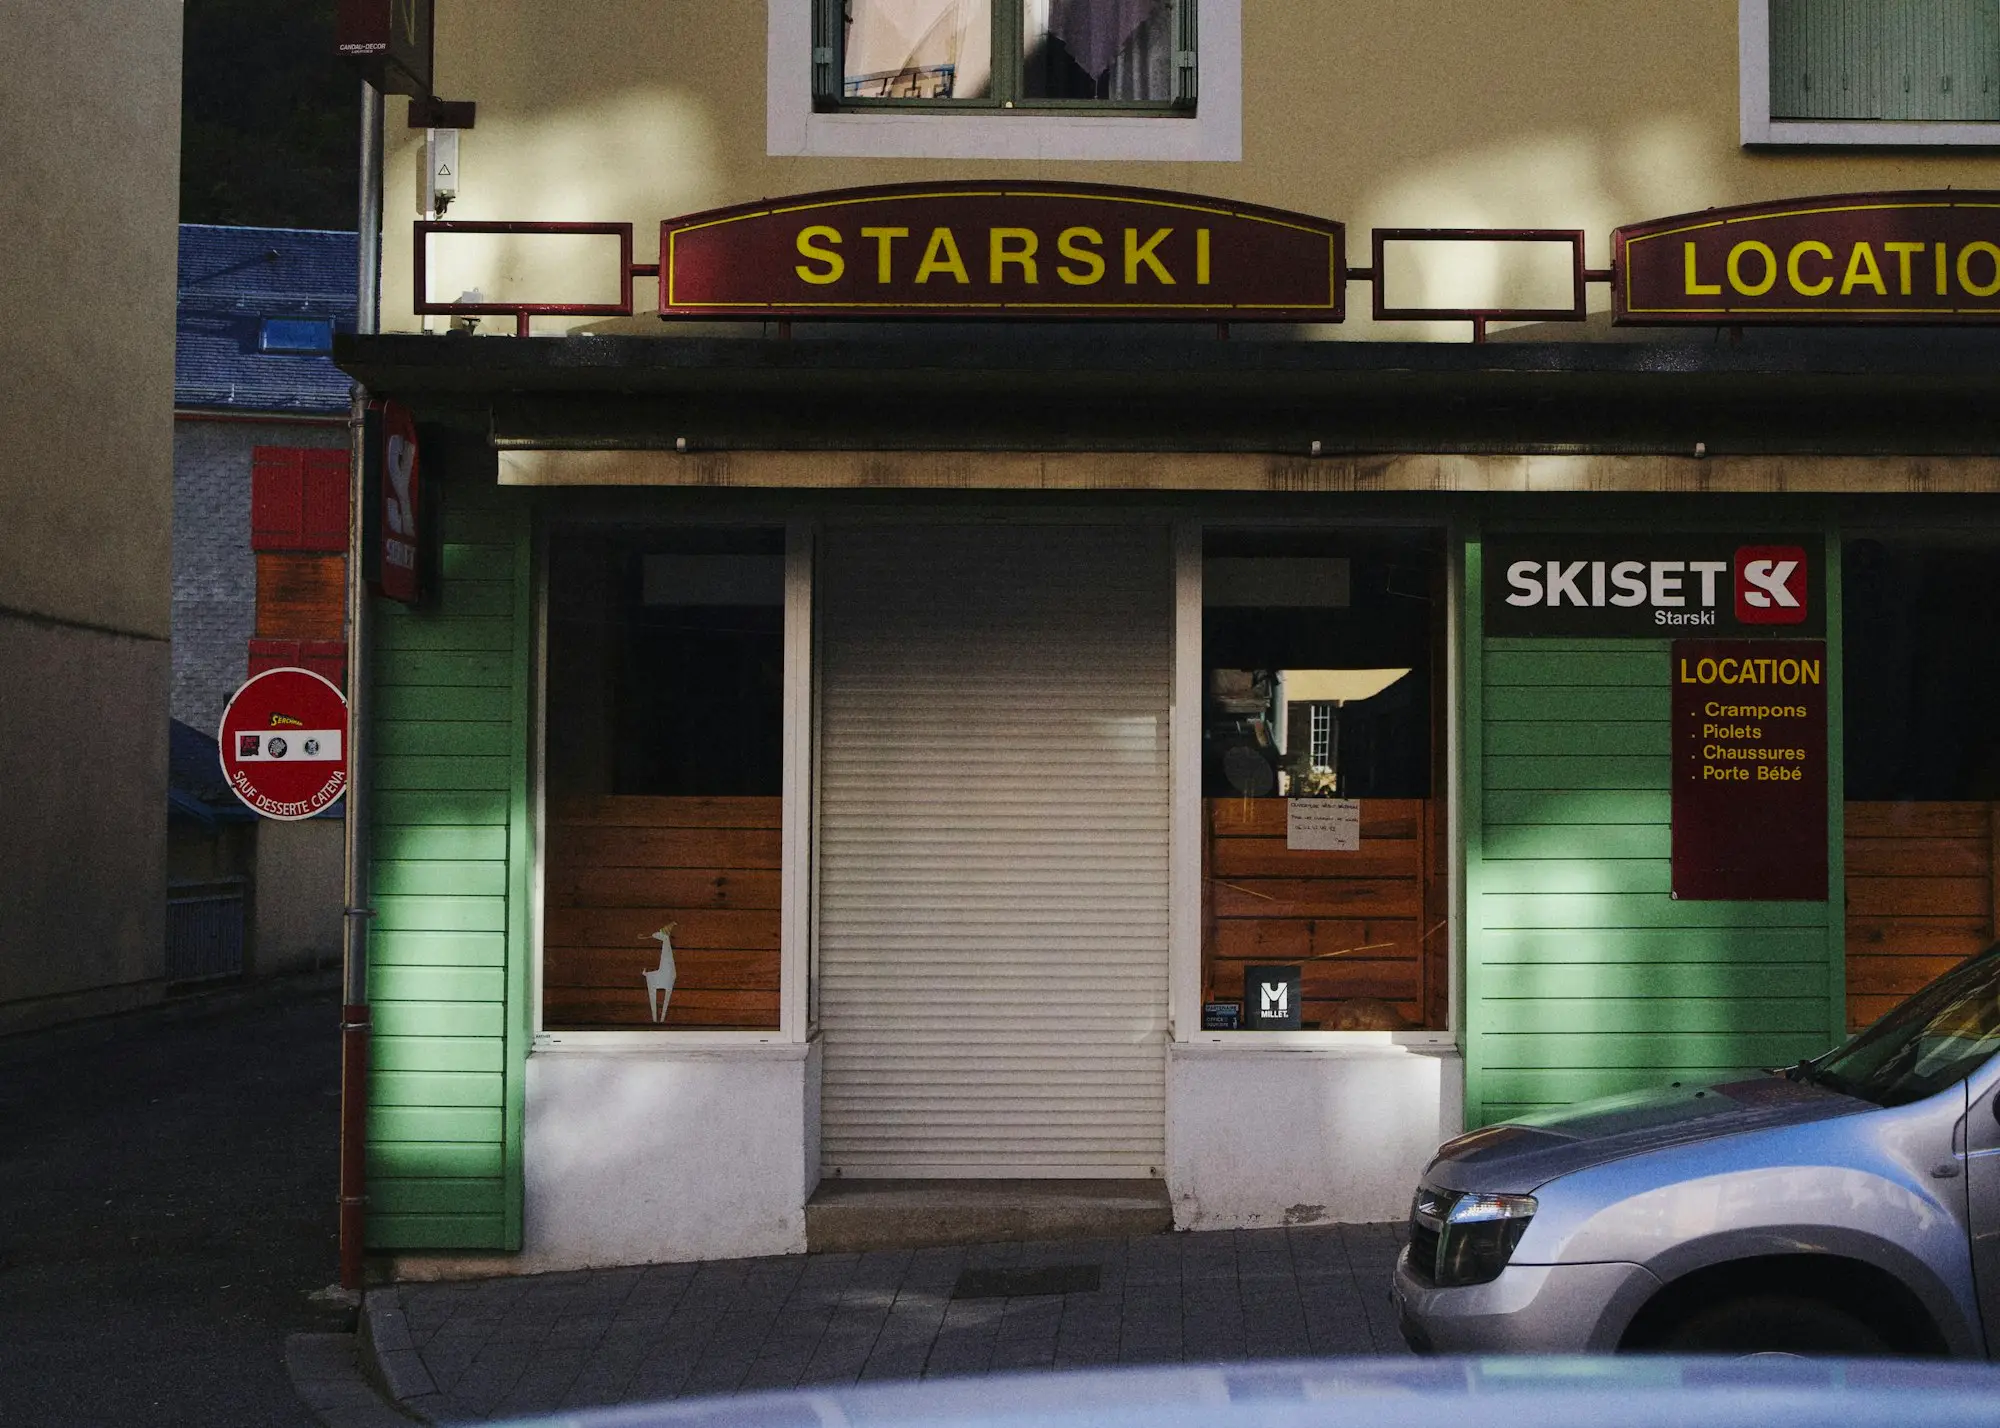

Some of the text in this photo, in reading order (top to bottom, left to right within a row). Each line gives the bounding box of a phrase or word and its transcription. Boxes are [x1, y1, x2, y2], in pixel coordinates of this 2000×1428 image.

[795, 225, 1211, 286] STARSKI
[1684, 240, 2000, 297] LOCATIO
[1505, 560, 1727, 607] SKISET
[1654, 609, 1715, 625] Starski
[1680, 658, 1820, 685] LOCATION
[1704, 701, 1807, 720] Crampons
[1703, 723, 1762, 739] Piolets
[1703, 744, 1806, 761] Chaussures
[1703, 764, 1802, 781] Porte Bébé
[233, 770, 345, 816] SAUF DESSERTE CATENA
[1261, 1010, 1287, 1018] MILLET
